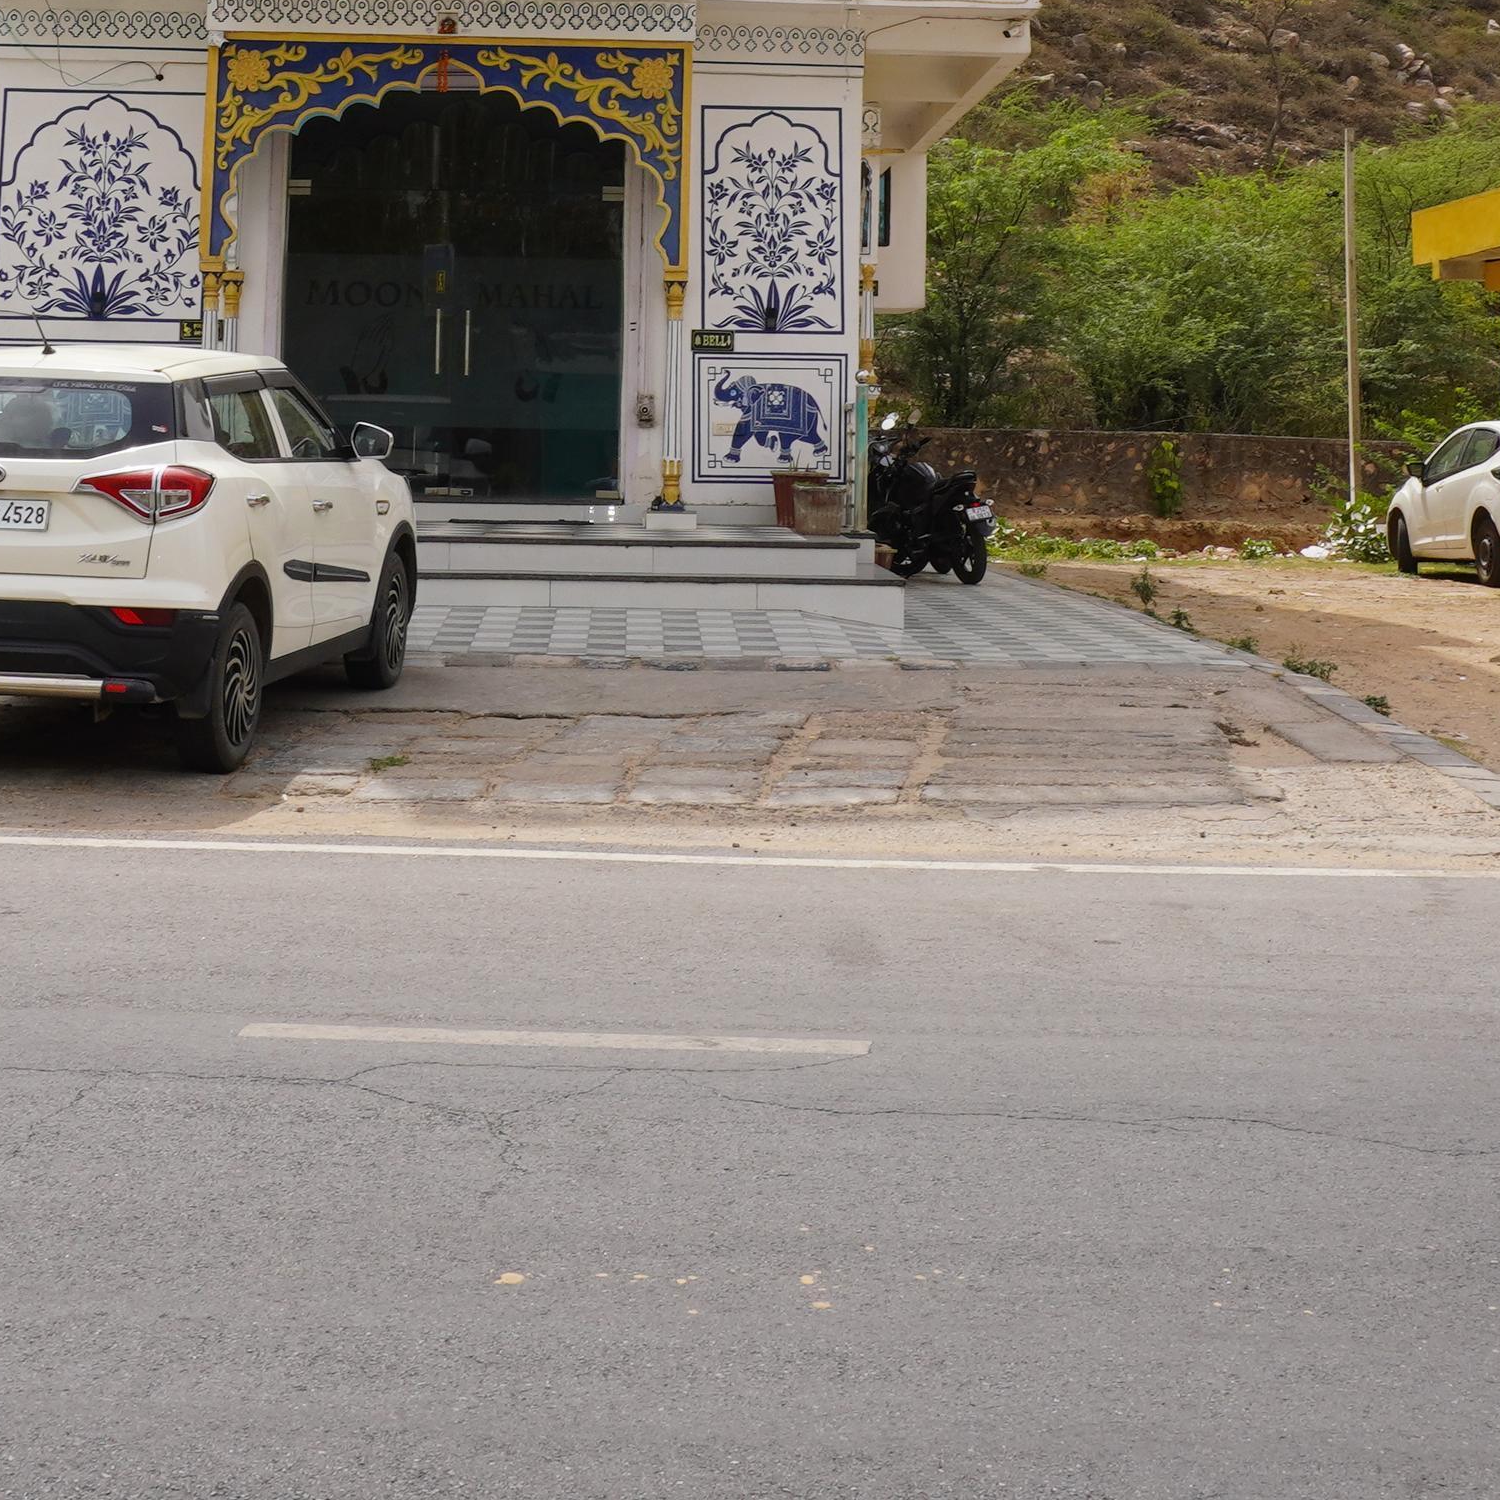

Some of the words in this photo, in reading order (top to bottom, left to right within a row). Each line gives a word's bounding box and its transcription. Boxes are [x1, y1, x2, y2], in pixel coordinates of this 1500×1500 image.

[304, 279, 426, 307] MOON
[477, 283, 605, 309] MAHAL
[703, 335, 726, 347] BELL
